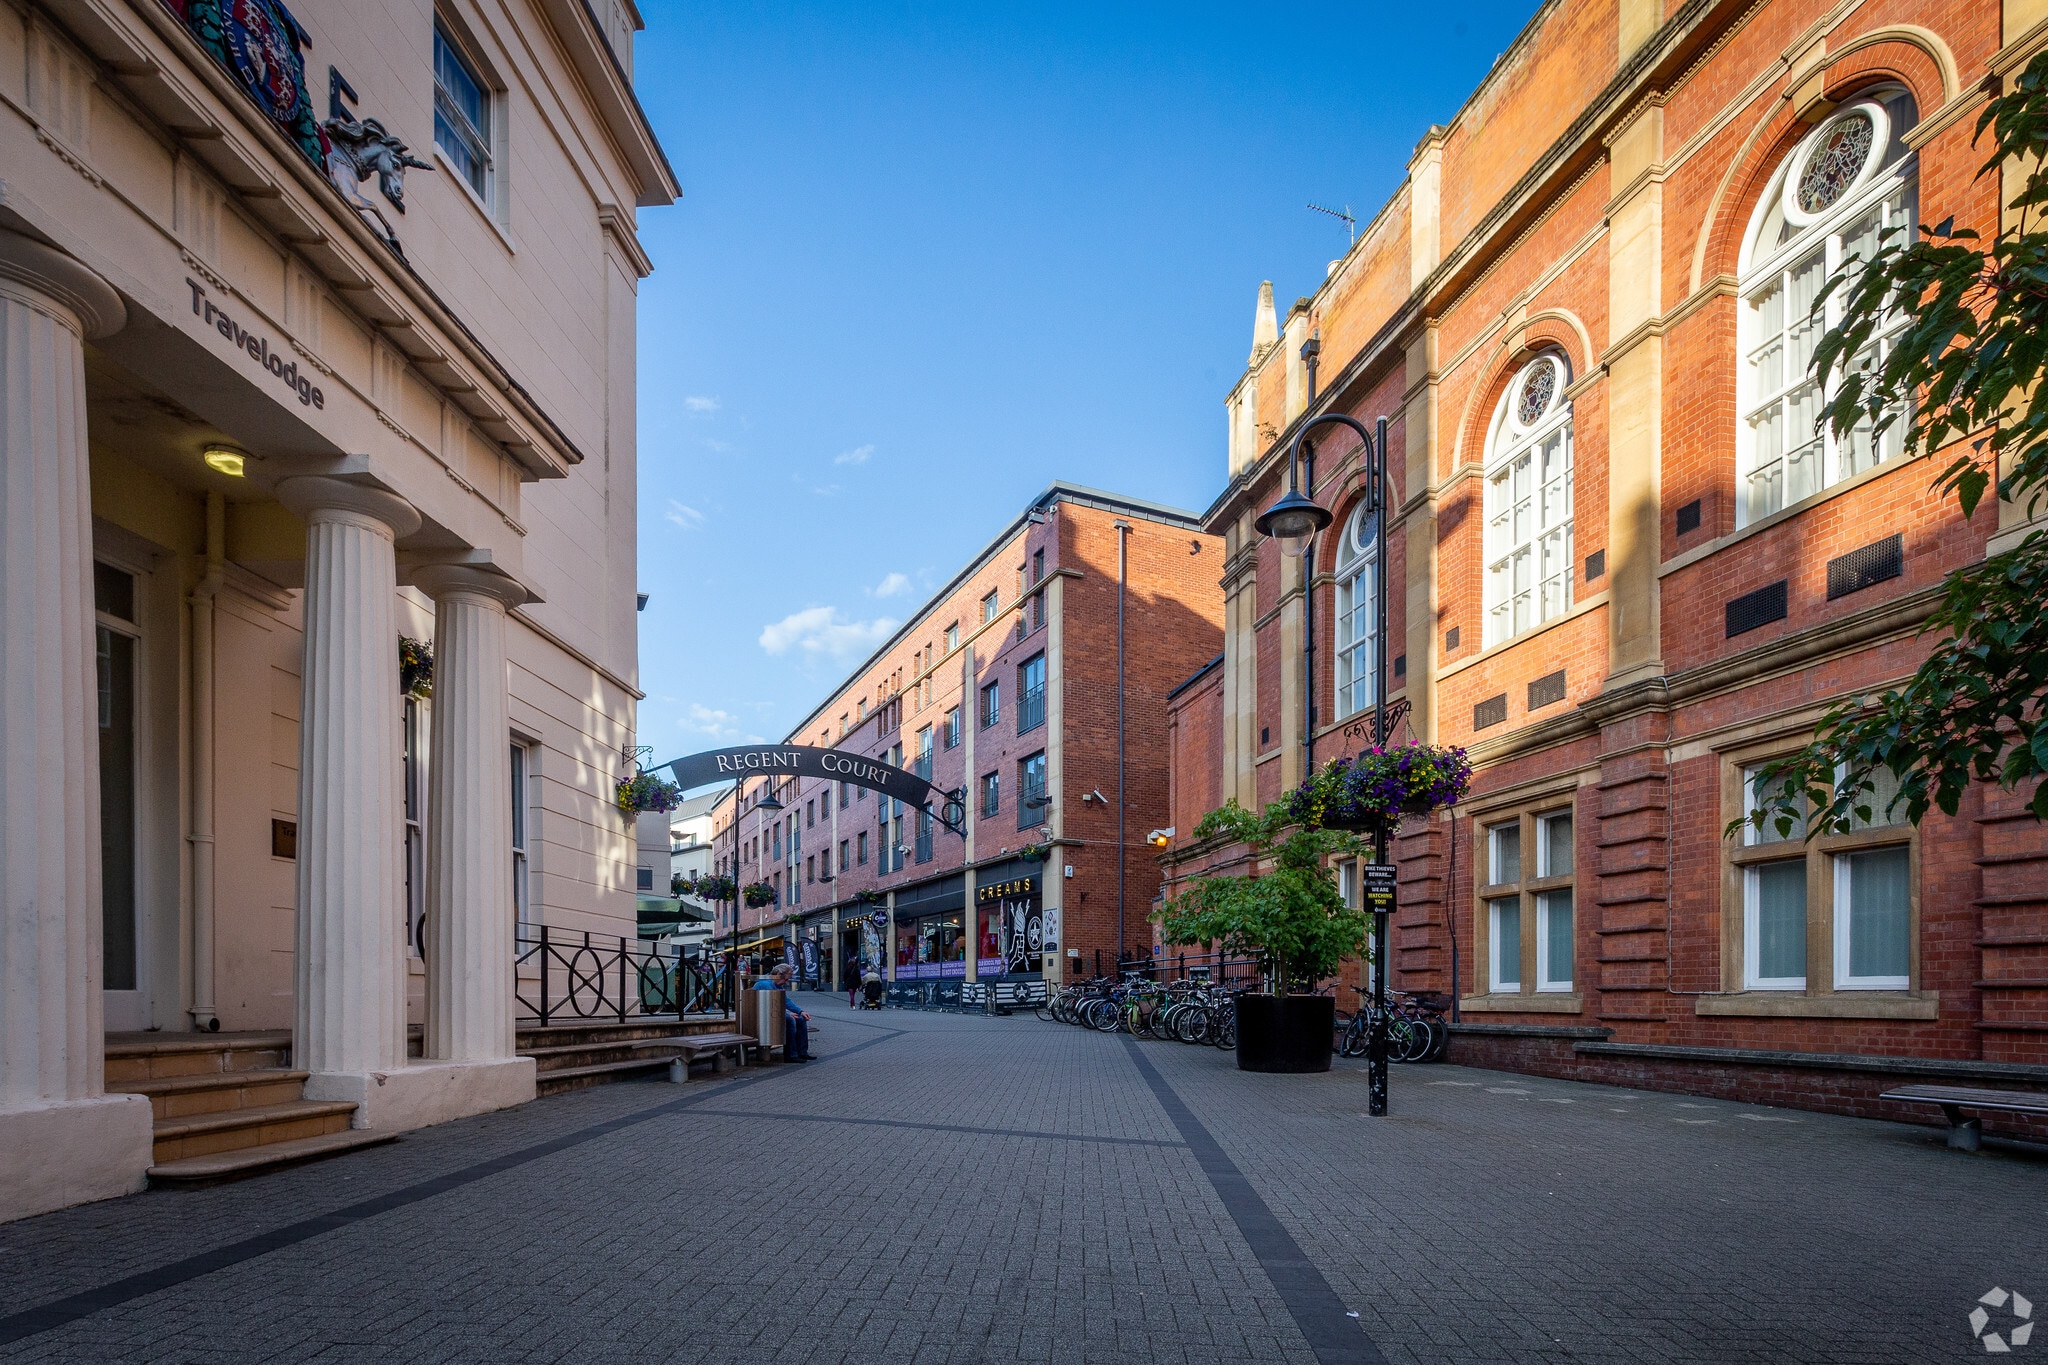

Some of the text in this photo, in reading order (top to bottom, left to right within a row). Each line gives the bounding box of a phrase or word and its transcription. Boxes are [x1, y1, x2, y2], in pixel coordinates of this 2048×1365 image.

[185, 276, 325, 411] Travelodge
[714, 751, 892, 786] REGENT COURT
[979, 877, 1031, 901] CREAMS
